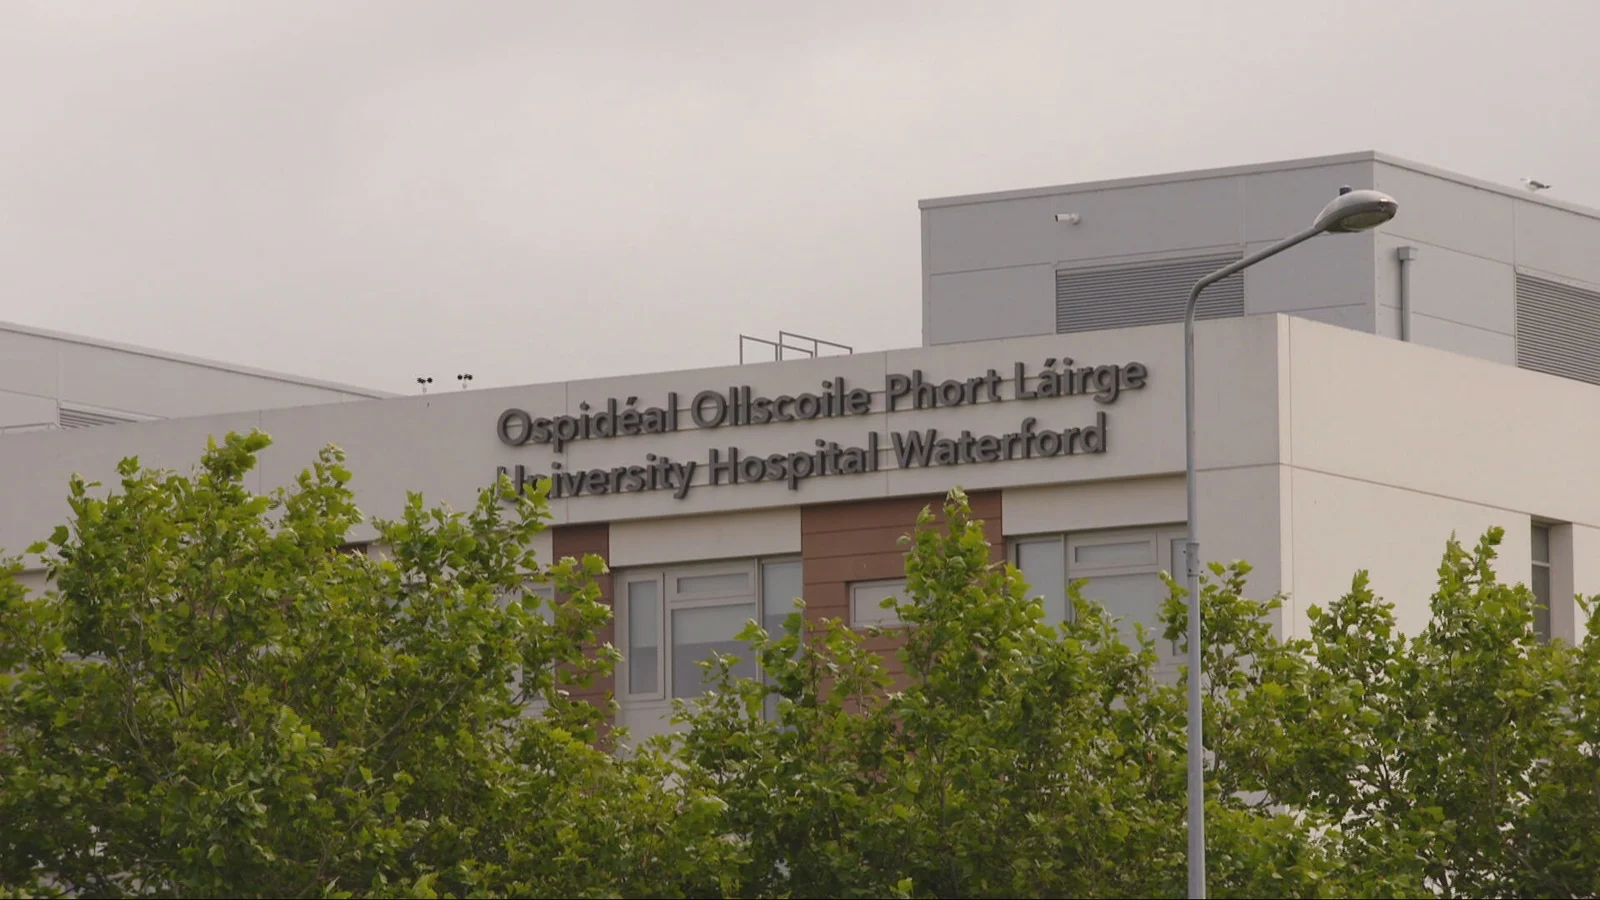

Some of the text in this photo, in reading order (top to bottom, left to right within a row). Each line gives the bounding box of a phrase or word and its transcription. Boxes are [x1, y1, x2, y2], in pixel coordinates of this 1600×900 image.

[497, 357, 1147, 453] Ospidéal Ollscoile Phort Láirge
[709, 431, 878, 490] Hospital
[891, 411, 1106, 469] Waterford
